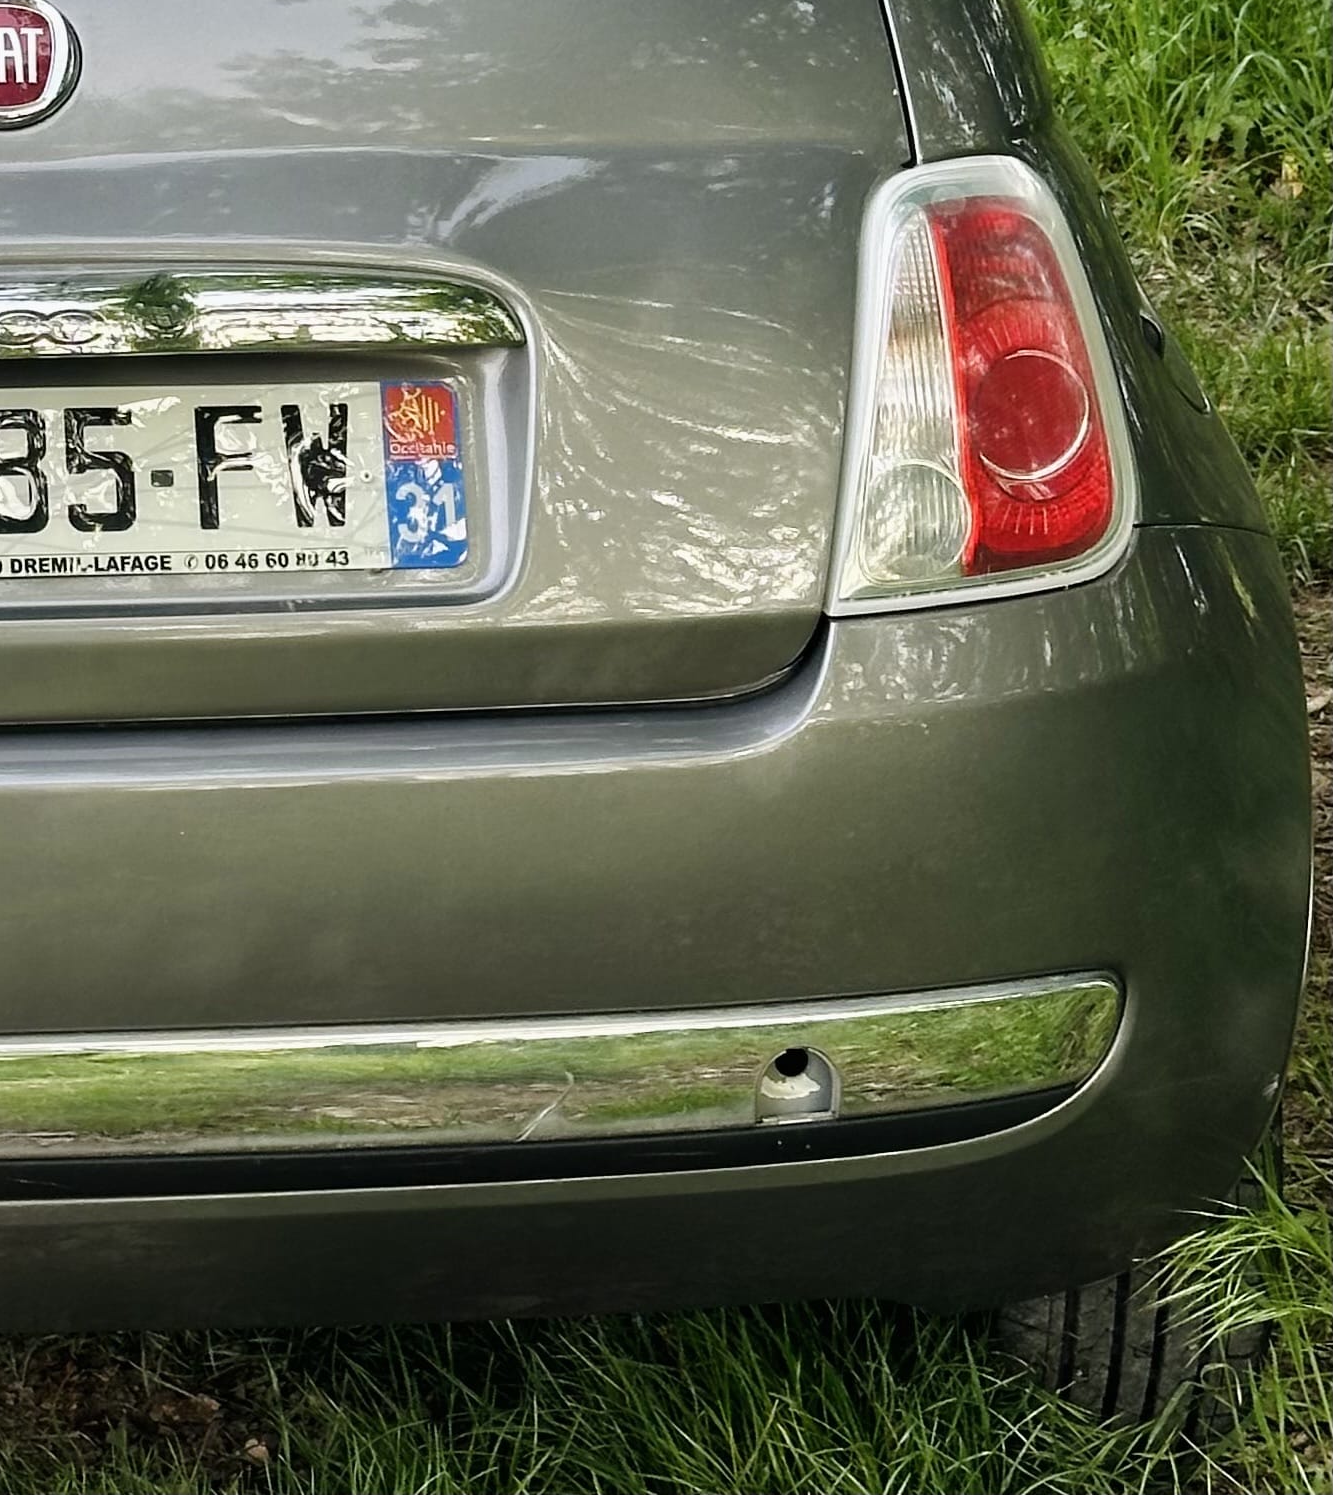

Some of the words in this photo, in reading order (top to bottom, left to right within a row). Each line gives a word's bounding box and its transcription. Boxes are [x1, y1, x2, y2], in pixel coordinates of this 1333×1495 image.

[205, 553, 228, 570] 06
[235, 553, 258, 570] 46
[266, 552, 289, 568] 60
[326, 550, 349, 566] 43
